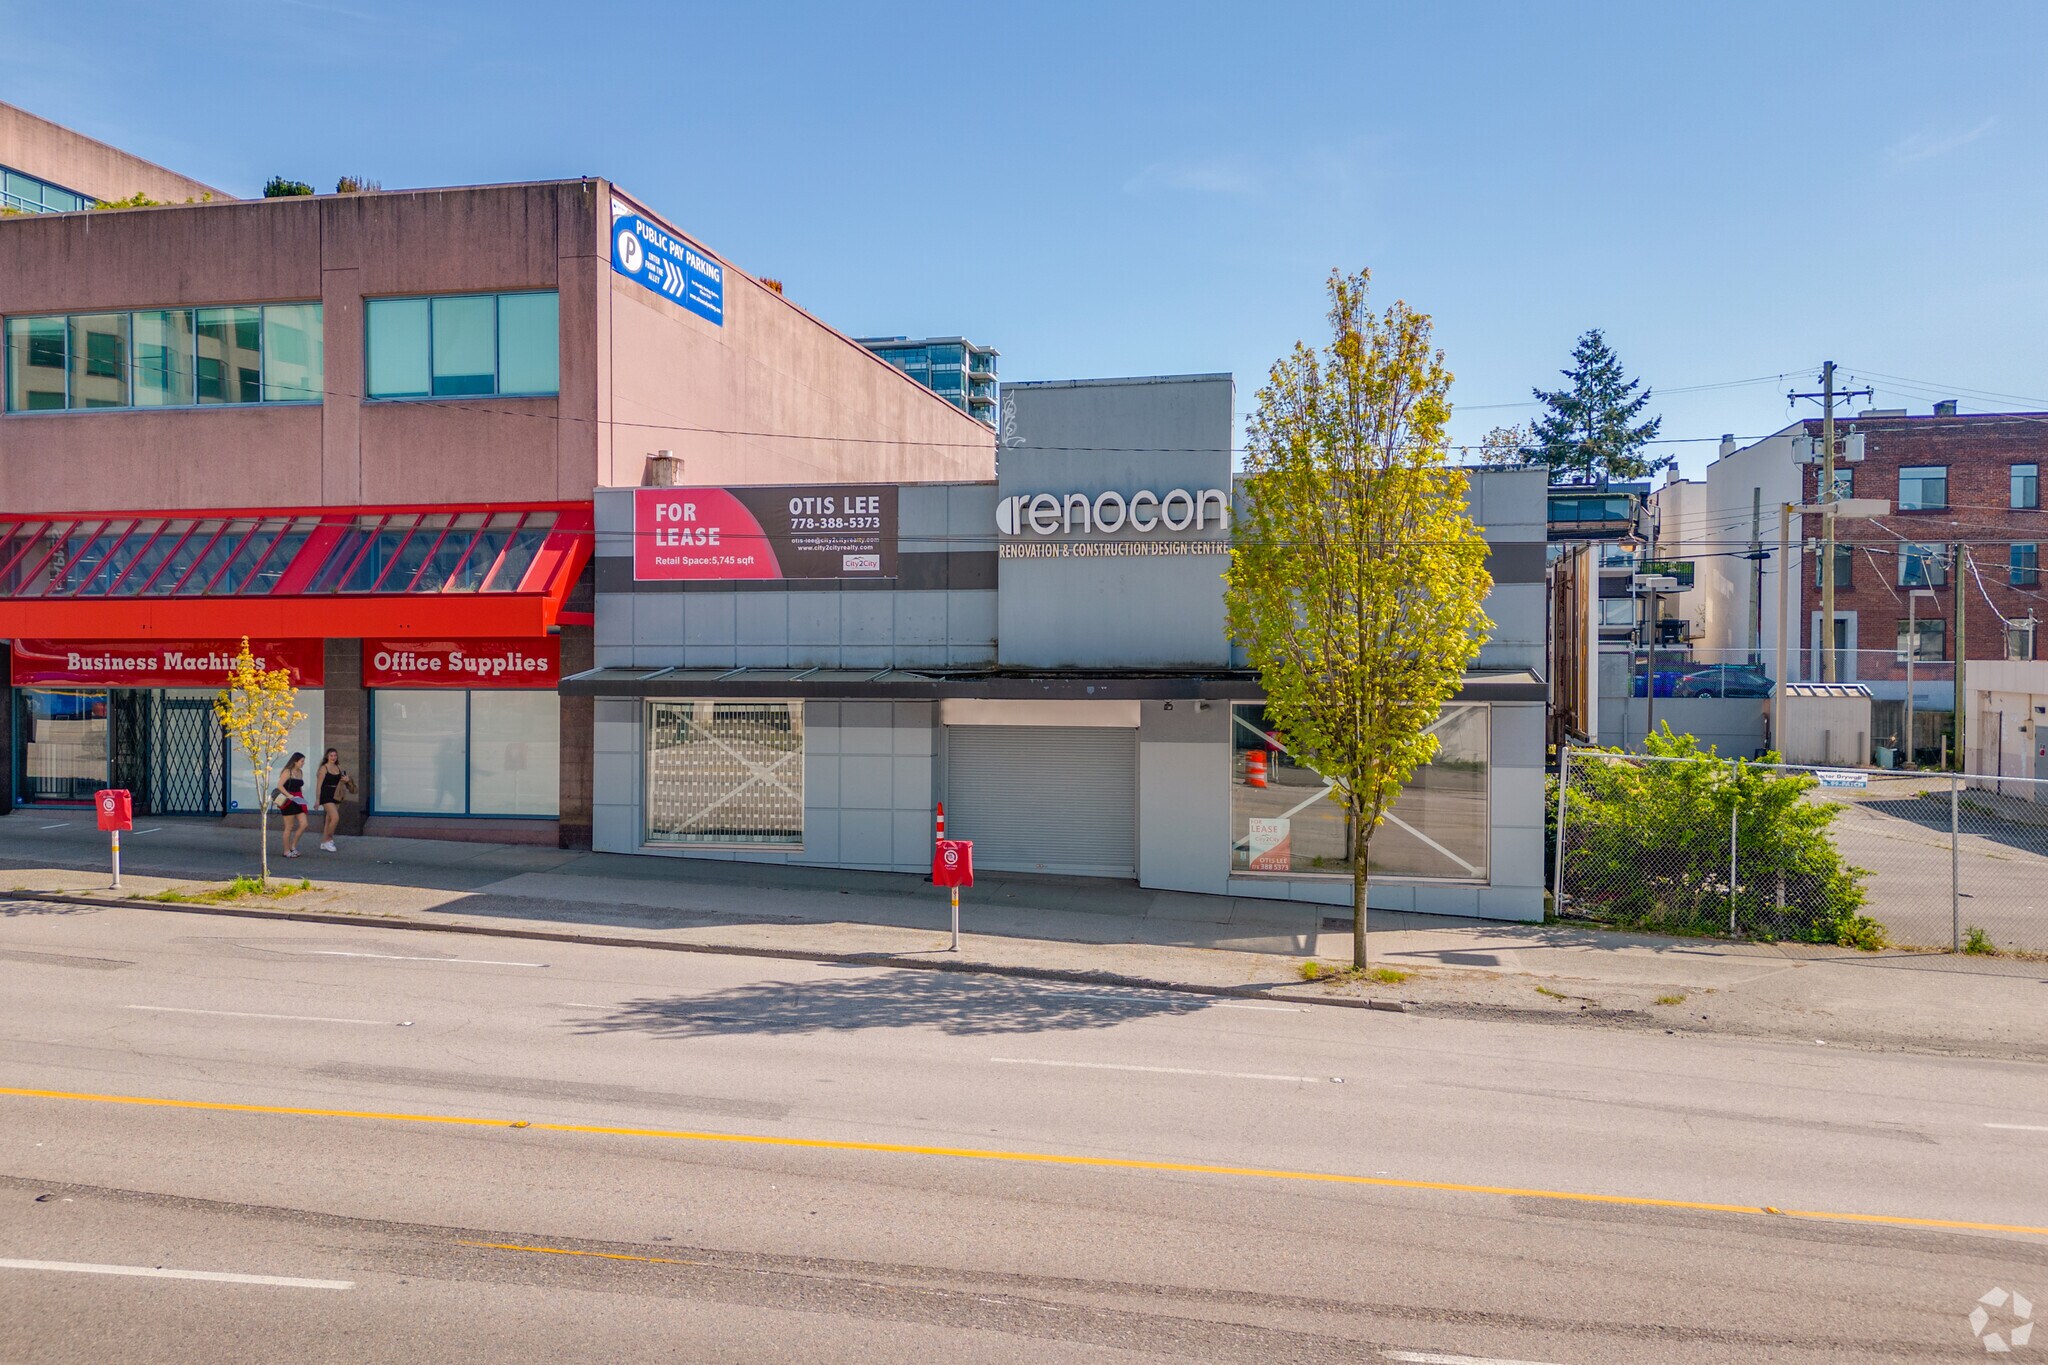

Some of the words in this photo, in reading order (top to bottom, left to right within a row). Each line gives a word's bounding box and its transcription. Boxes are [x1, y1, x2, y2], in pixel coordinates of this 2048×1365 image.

[626, 236, 636, 264] P
[636, 220, 668, 252] PUBLIC
[669, 240, 685, 261] PAY
[686, 251, 720, 283] PARKING
[648, 272, 660, 285] ALLEY
[655, 503, 697, 522] FOR
[789, 496, 835, 515] OTIS
[843, 496, 880, 514] LEE
[1010, 488, 1228, 536] renocon
[790, 517, 880, 529] 778-388-5373
[655, 527, 720, 547] LEASE
[797, 544, 874, 552] www.city2cityrealty.com
[999, 543, 1060, 559] RENOVATION
[1062, 544, 1070, 557] &
[1073, 541, 1149, 558] CONSTRUCTION
[1151, 541, 1188, 557] DESIGN
[1191, 541, 1229, 555] CENTRE
[655, 556, 680, 565] Retail
[736, 555, 755, 566] sqft
[845, 560, 877, 569] City2City
[67, 652, 157, 671] Business
[163, 652, 266, 671] Machins
[373, 652, 442, 671] Office
[448, 652, 548, 676] Supplies
[1251, 825, 1278, 833] LEASE
